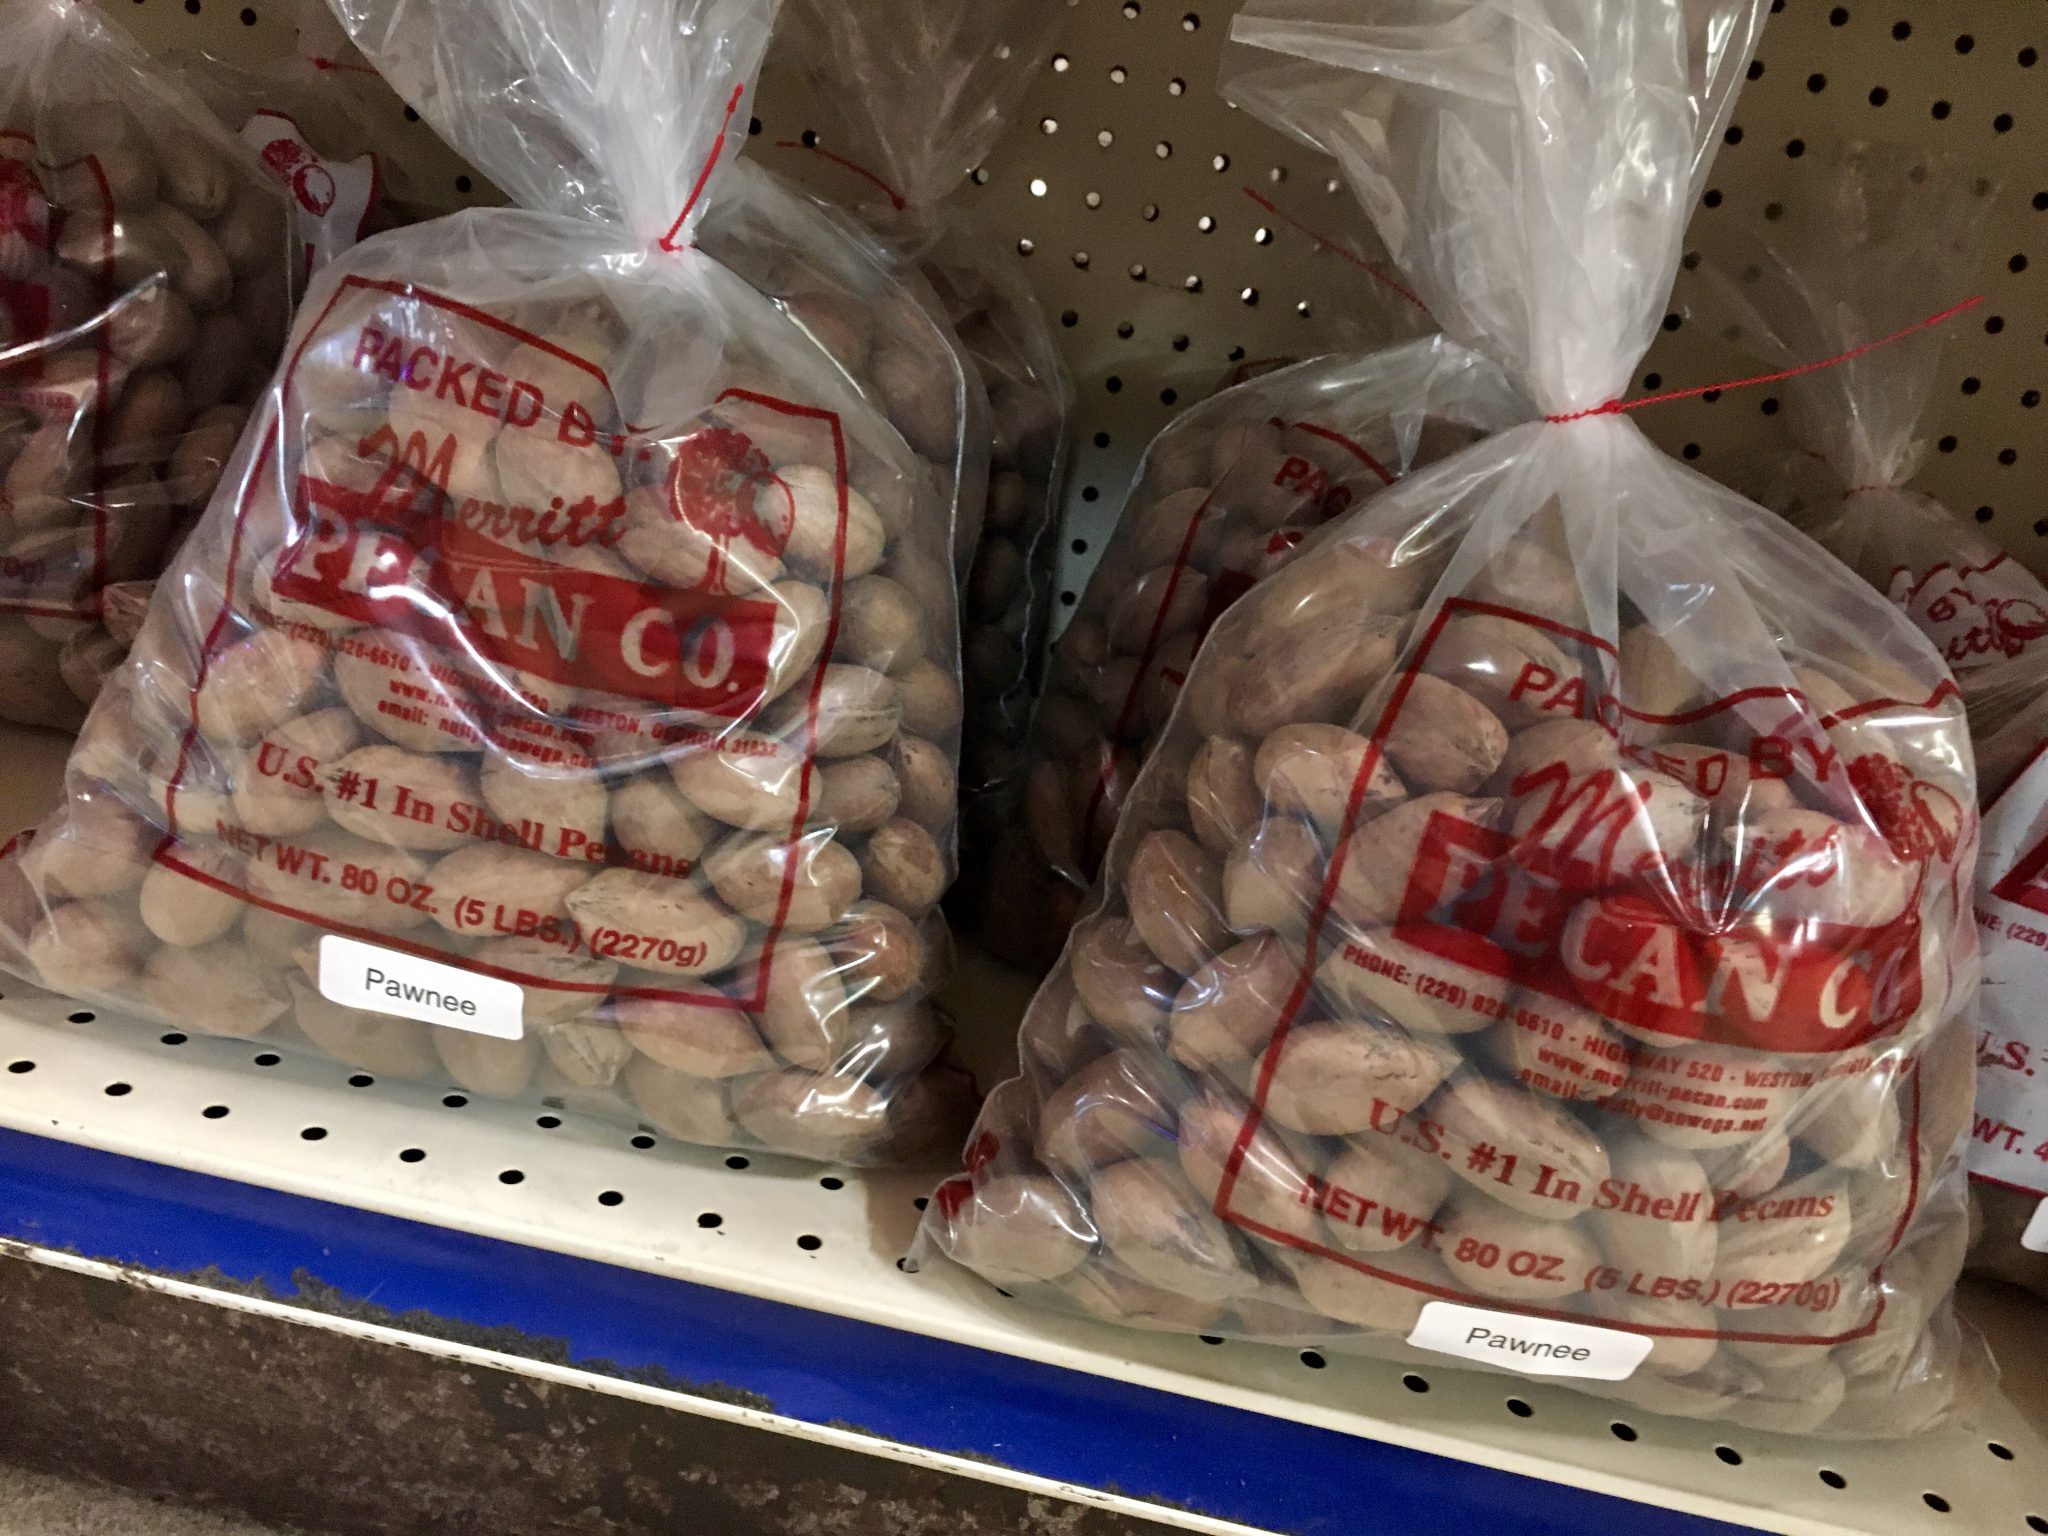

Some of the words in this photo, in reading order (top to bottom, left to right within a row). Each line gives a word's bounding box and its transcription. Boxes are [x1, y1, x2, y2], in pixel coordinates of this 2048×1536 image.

[352, 326, 544, 428] PACKED
[357, 423, 627, 549] Merritt
[290, 512, 597, 662] PEAN
[620, 607, 740, 693] CO.
[256, 742, 325, 793] U.S.
[336, 764, 380, 811] #1
[394, 783, 434, 824] In
[446, 803, 544, 858] Shell
[1750, 735, 1837, 783] BY
[1510, 760, 1837, 892] Meitt
[216, 818, 270, 863] NET
[275, 846, 331, 885] WT.
[340, 863, 379, 896] 80
[385, 878, 439, 915] OZ.
[453, 895, 485, 930] (5
[493, 904, 582, 955] LBS.)
[590, 926, 708, 969] (2270g)
[1426, 843, 1796, 1023] PECAN
[365, 968, 478, 1017] Pawnee
[1342, 943, 1412, 987] PHONE:
[1415, 973, 1467, 1010] (229)
[1686, 1060, 1724, 1083] 520
[1369, 1097, 1453, 1160] U.S.
[1466, 1141, 1518, 1187] #1
[1529, 1163, 1582, 1204] In
[1591, 1178, 1703, 1223] Shell
[1706, 1189, 1835, 1223] Pecans
[1298, 1172, 1378, 1229] NET
[1381, 1206, 1446, 1255] WT.
[1454, 1237, 1501, 1270] 80
[1507, 1250, 1566, 1283] OZ.
[1584, 1265, 1622, 1293] (5
[1626, 1272, 1721, 1308] LBS.)
[1726, 1276, 1841, 1313] (2270g)
[1464, 1324, 1592, 1364] Pawnee
